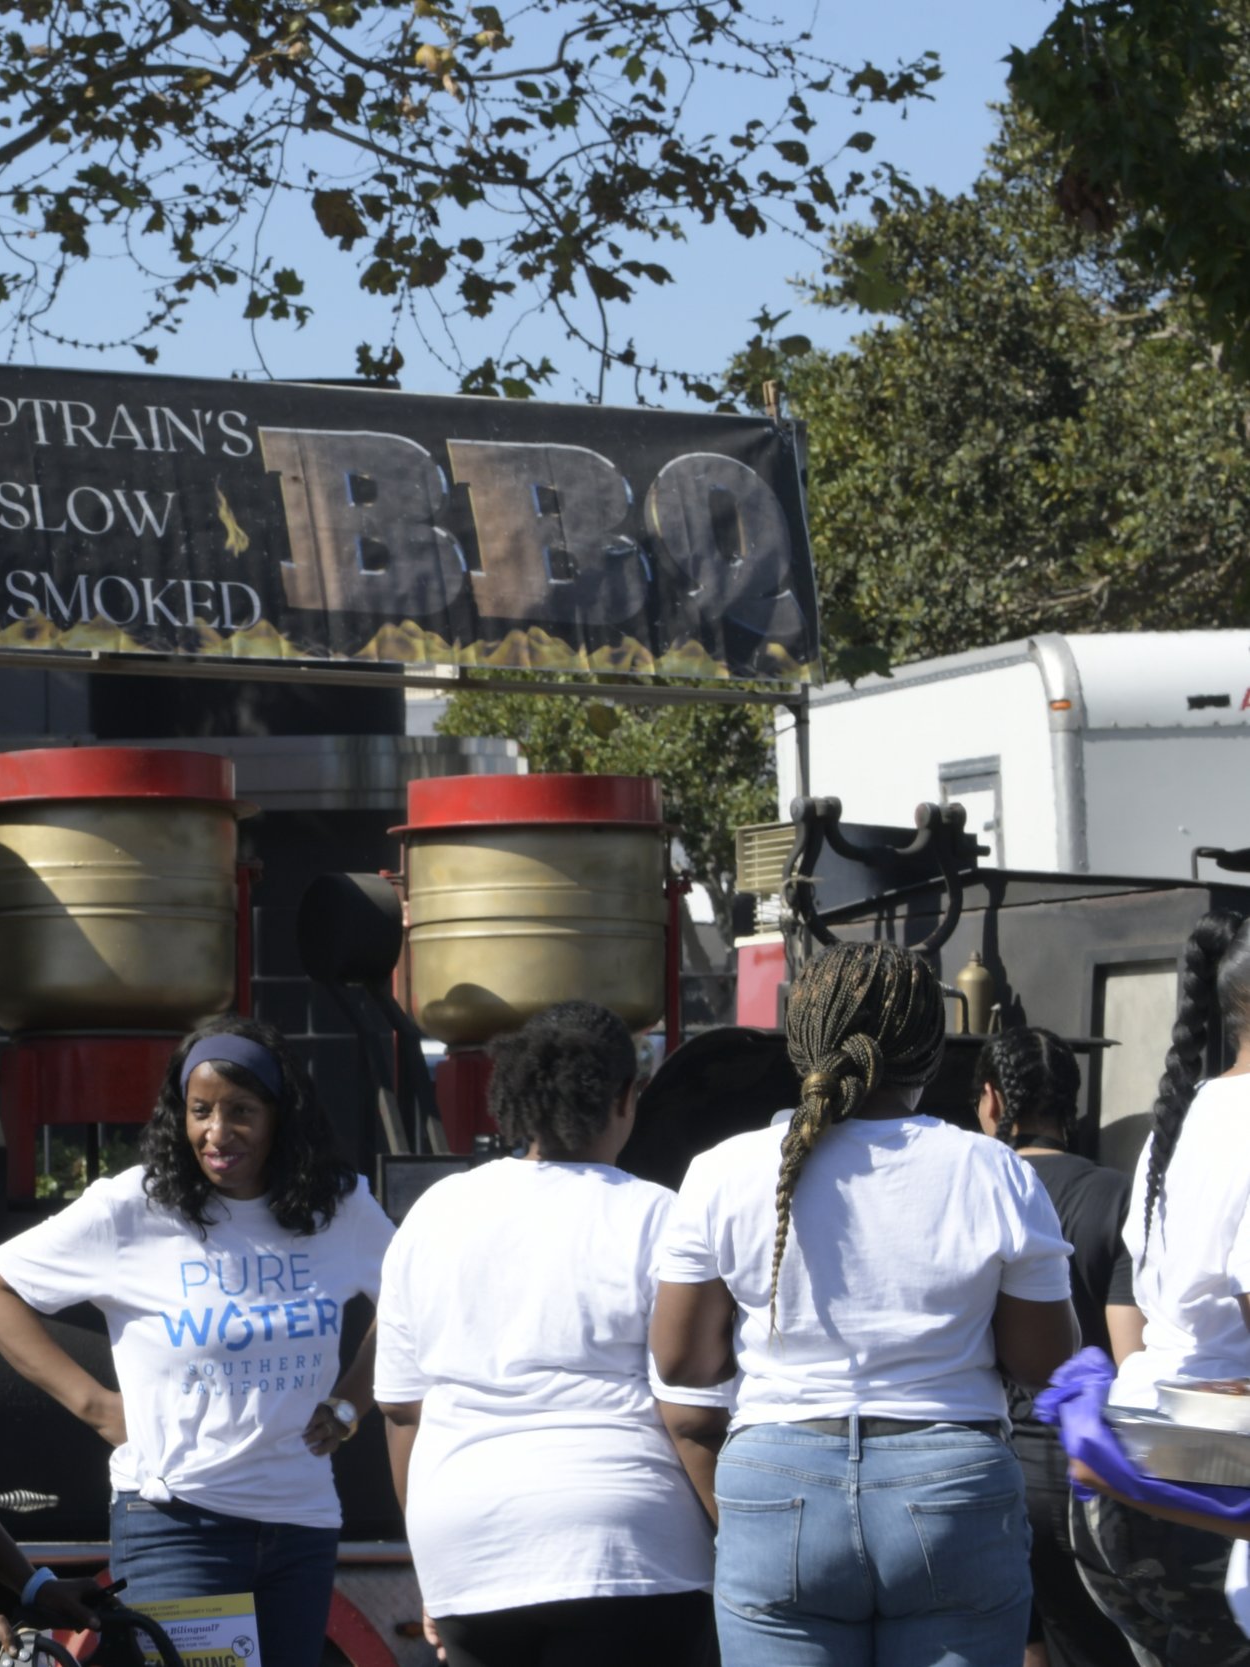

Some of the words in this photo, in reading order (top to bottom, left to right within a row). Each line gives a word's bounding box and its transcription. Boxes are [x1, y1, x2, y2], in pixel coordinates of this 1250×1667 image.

[257, 426, 808, 637] BBQ
[5, 569, 261, 630] SMOKED
[180, 1253, 314, 1299] PURE
[188, 1352, 323, 1377] SOUTHERN
[181, 1374, 318, 1397] CALIFORNI
[170, 1623, 221, 1635] Bilingual?
